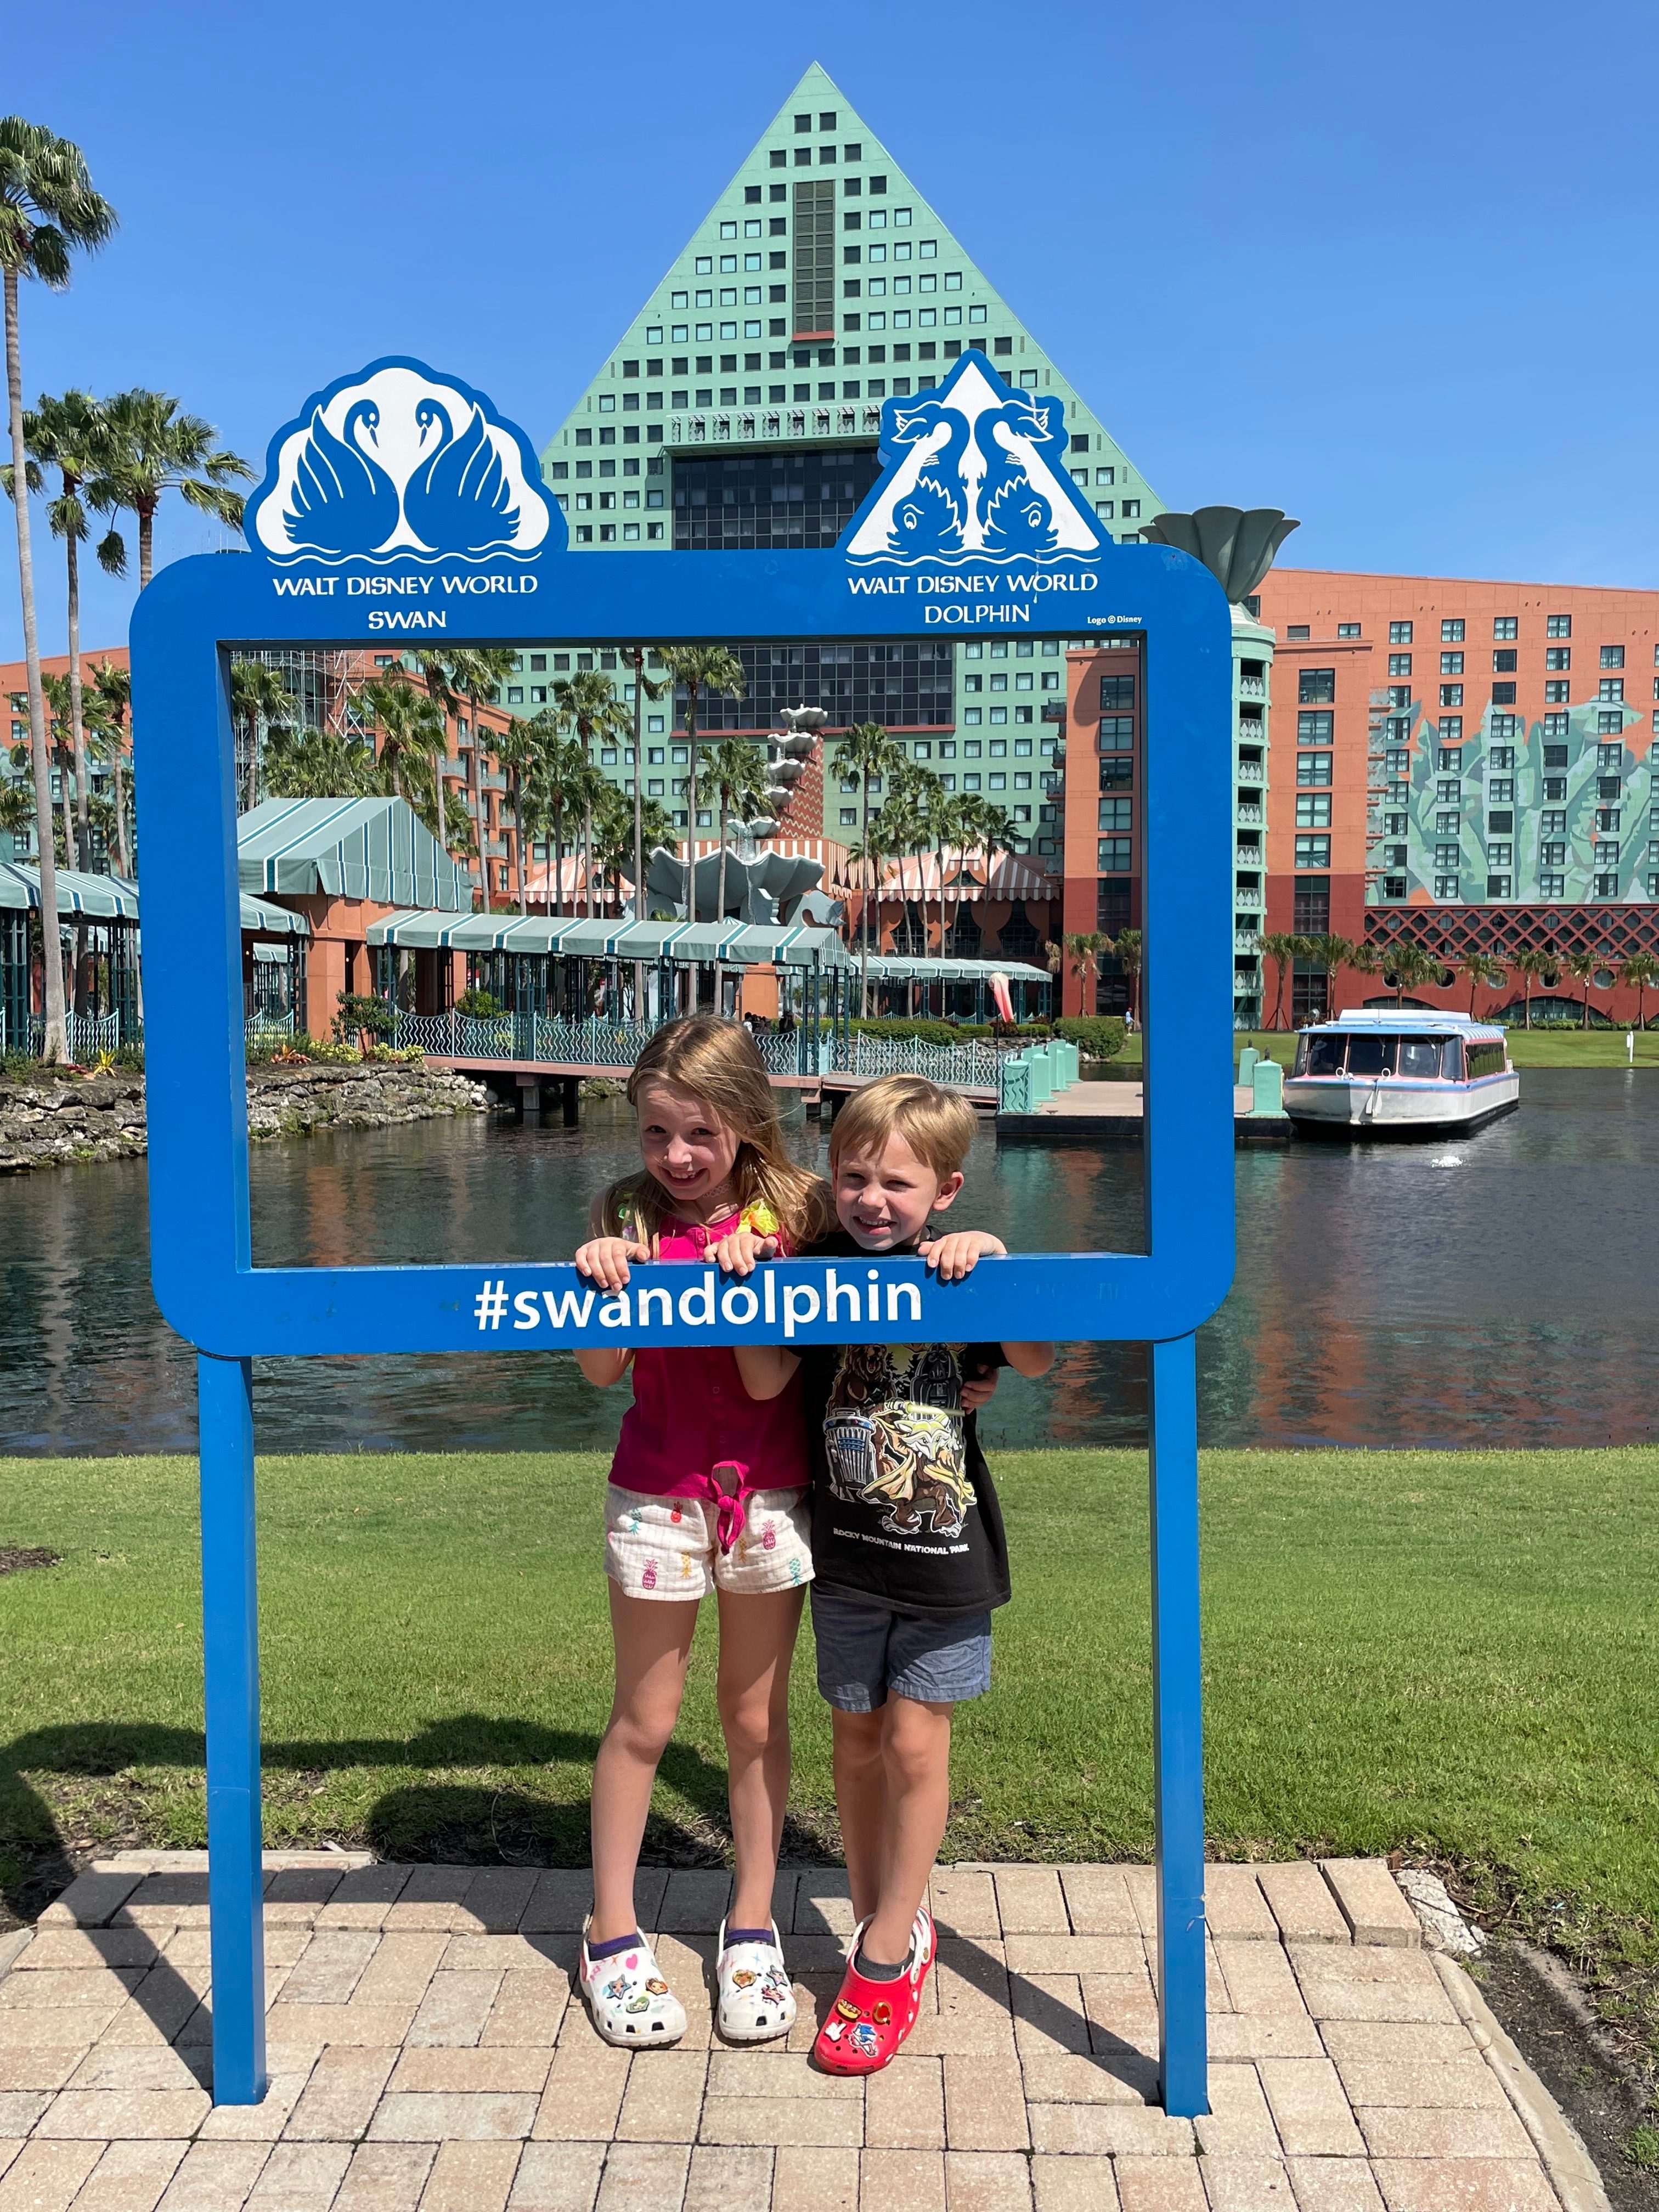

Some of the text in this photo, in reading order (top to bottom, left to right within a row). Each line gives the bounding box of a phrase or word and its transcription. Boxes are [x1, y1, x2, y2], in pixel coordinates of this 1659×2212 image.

[272, 575, 538, 596] WALT DISNEY WORLD
[848, 573, 1098, 595] WALT DISNEY WORLD
[368, 611, 447, 629] SWAN
[924, 604, 1030, 623] DOLPHIN
[1087, 616, 1107, 625] Logo
[1116, 615, 1142, 624] Disney
[473, 1268, 922, 1338] #swandolphin
[833, 1527, 970, 1555] ROCKY MOUNTAIN NATIONAL PARK
